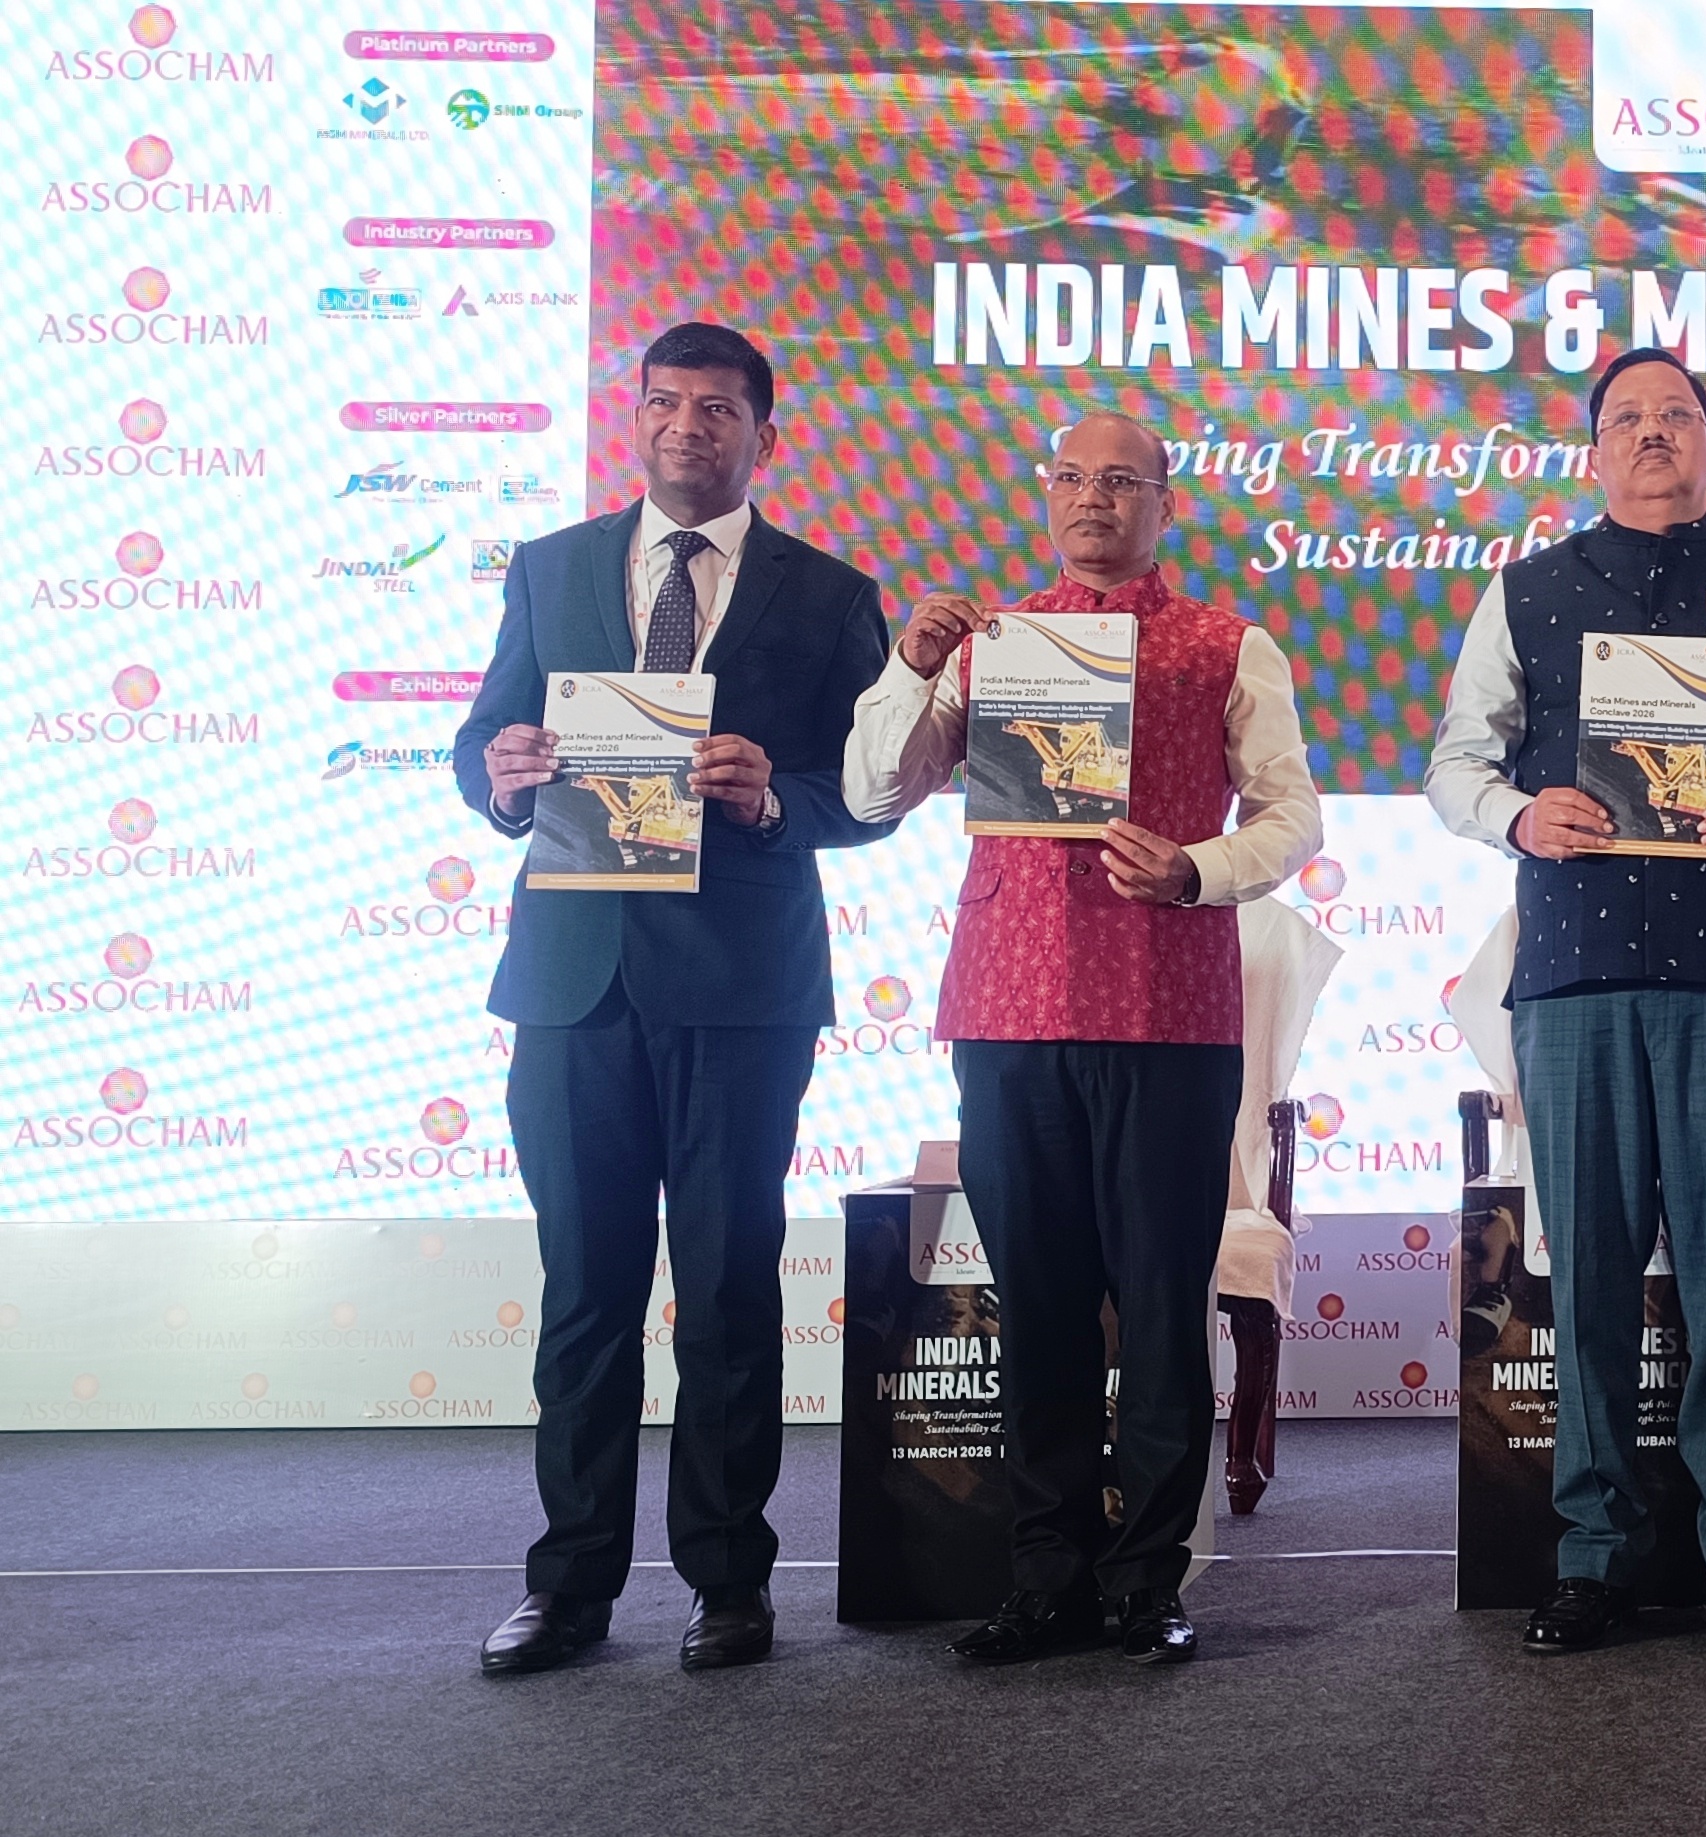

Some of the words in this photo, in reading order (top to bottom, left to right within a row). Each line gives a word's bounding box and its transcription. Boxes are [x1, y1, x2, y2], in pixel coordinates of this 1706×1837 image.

[360, 35, 449, 53] Platinum
[453, 38, 538, 54] Partners
[45, 49, 274, 82] ASSOCHAM
[41, 181, 272, 213] ASSOCHAM
[364, 223, 447, 243] Industry
[450, 225, 533, 241] Partners
[484, 292, 524, 305] AXIS
[530, 292, 578, 306] BANK
[38, 312, 268, 345] ASSOCHAM
[932, 262, 1193, 367] INDIA
[1221, 264, 1514, 372] MINES
[1545, 267, 1604, 373] &
[375, 406, 430, 424] Silver
[434, 408, 516, 424] Partners
[34, 444, 265, 477] ASSOCHAM
[334, 474, 417, 498] JSW
[420, 478, 482, 494] Cement
[312, 557, 400, 578] JINDAL
[30, 578, 262, 610] ASSOCHAM
[373, 579, 415, 592] STEEL
[979, 687, 1022, 696] Conclave
[1025, 688, 1048, 696] 2026
[980, 676, 1002, 684] India
[1005, 676, 1031, 685] Mines
[1034, 677, 1051, 685] and
[1053, 677, 1090, 686] Minerals
[1589, 707, 1630, 717] Conclave
[1632, 709, 1655, 718] 2026
[1590, 696, 1611, 704] India
[1614, 697, 1639, 706] Mines
[1641, 698, 1657, 707] and
[1660, 699, 1695, 709] Minerals
[26, 711, 258, 744] ASSOCHAM
[576, 733, 602, 741] Mines
[605, 733, 622, 741] and
[625, 732, 663, 741] Minerals
[552, 744, 593, 752] Conclave
[595, 744, 619, 752] 2026
[23, 845, 255, 877] ASSOCHAM
[340, 905, 511, 936] ASSOCH
[18, 980, 252, 1012] ASSOCHAM
[1358, 1022, 1463, 1052] ASSO
[14, 1115, 248, 1148] ASSOCHAM
[333, 1146, 519, 1179] ASSOCH
[1296, 1141, 1441, 1172] OCHAM
[919, 1242, 989, 1265] ASSO
[1356, 1252, 1450, 1271] ASSOCH
[915, 1336, 984, 1366] INDIA
[877, 1371, 1000, 1401] MINERALS
[192, 1400, 326, 1422] ASSOCHAM
[893, 1410, 931, 1423] Shaping
[932, 1410, 1002, 1422] Transformation
[1509, 1400, 1546, 1413] Shaping
[924, 1423, 989, 1435] Sustainability
[892, 1448, 905, 1459] 13
[907, 1447, 957, 1459] MARCH
[960, 1446, 992, 1458] 2026
[1507, 1437, 1521, 1448] 13
